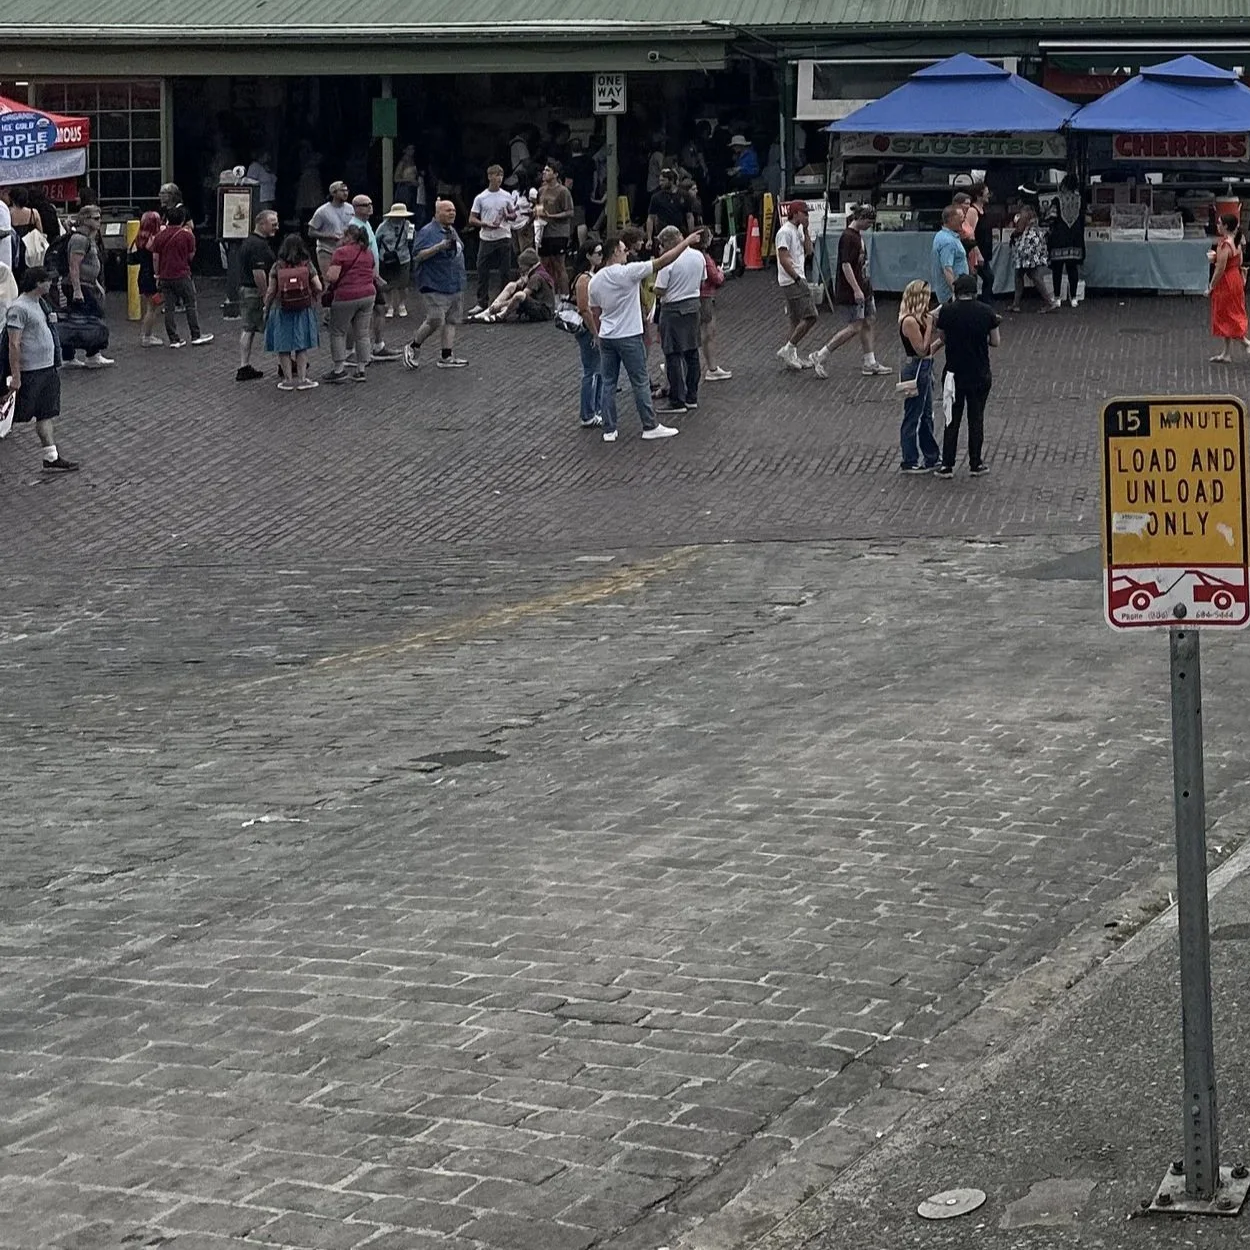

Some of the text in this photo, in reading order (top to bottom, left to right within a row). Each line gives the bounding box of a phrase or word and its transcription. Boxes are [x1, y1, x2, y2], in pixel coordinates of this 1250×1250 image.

[598, 76, 622, 86] ONE
[597, 86, 622, 97] WAY
[1, 112, 36, 122] ORGANIC
[55, 126, 82, 143] MOUS
[0, 143, 48, 159] IDER
[892, 137, 1044, 156] SLUSHIES
[1115, 134, 1247, 158] CHERRIES
[1117, 410, 1141, 431] 15
[1118, 448, 1235, 473] LOAD AND
[1127, 479, 1224, 504] UNLOAD
[1147, 512, 1209, 536] ONLY
